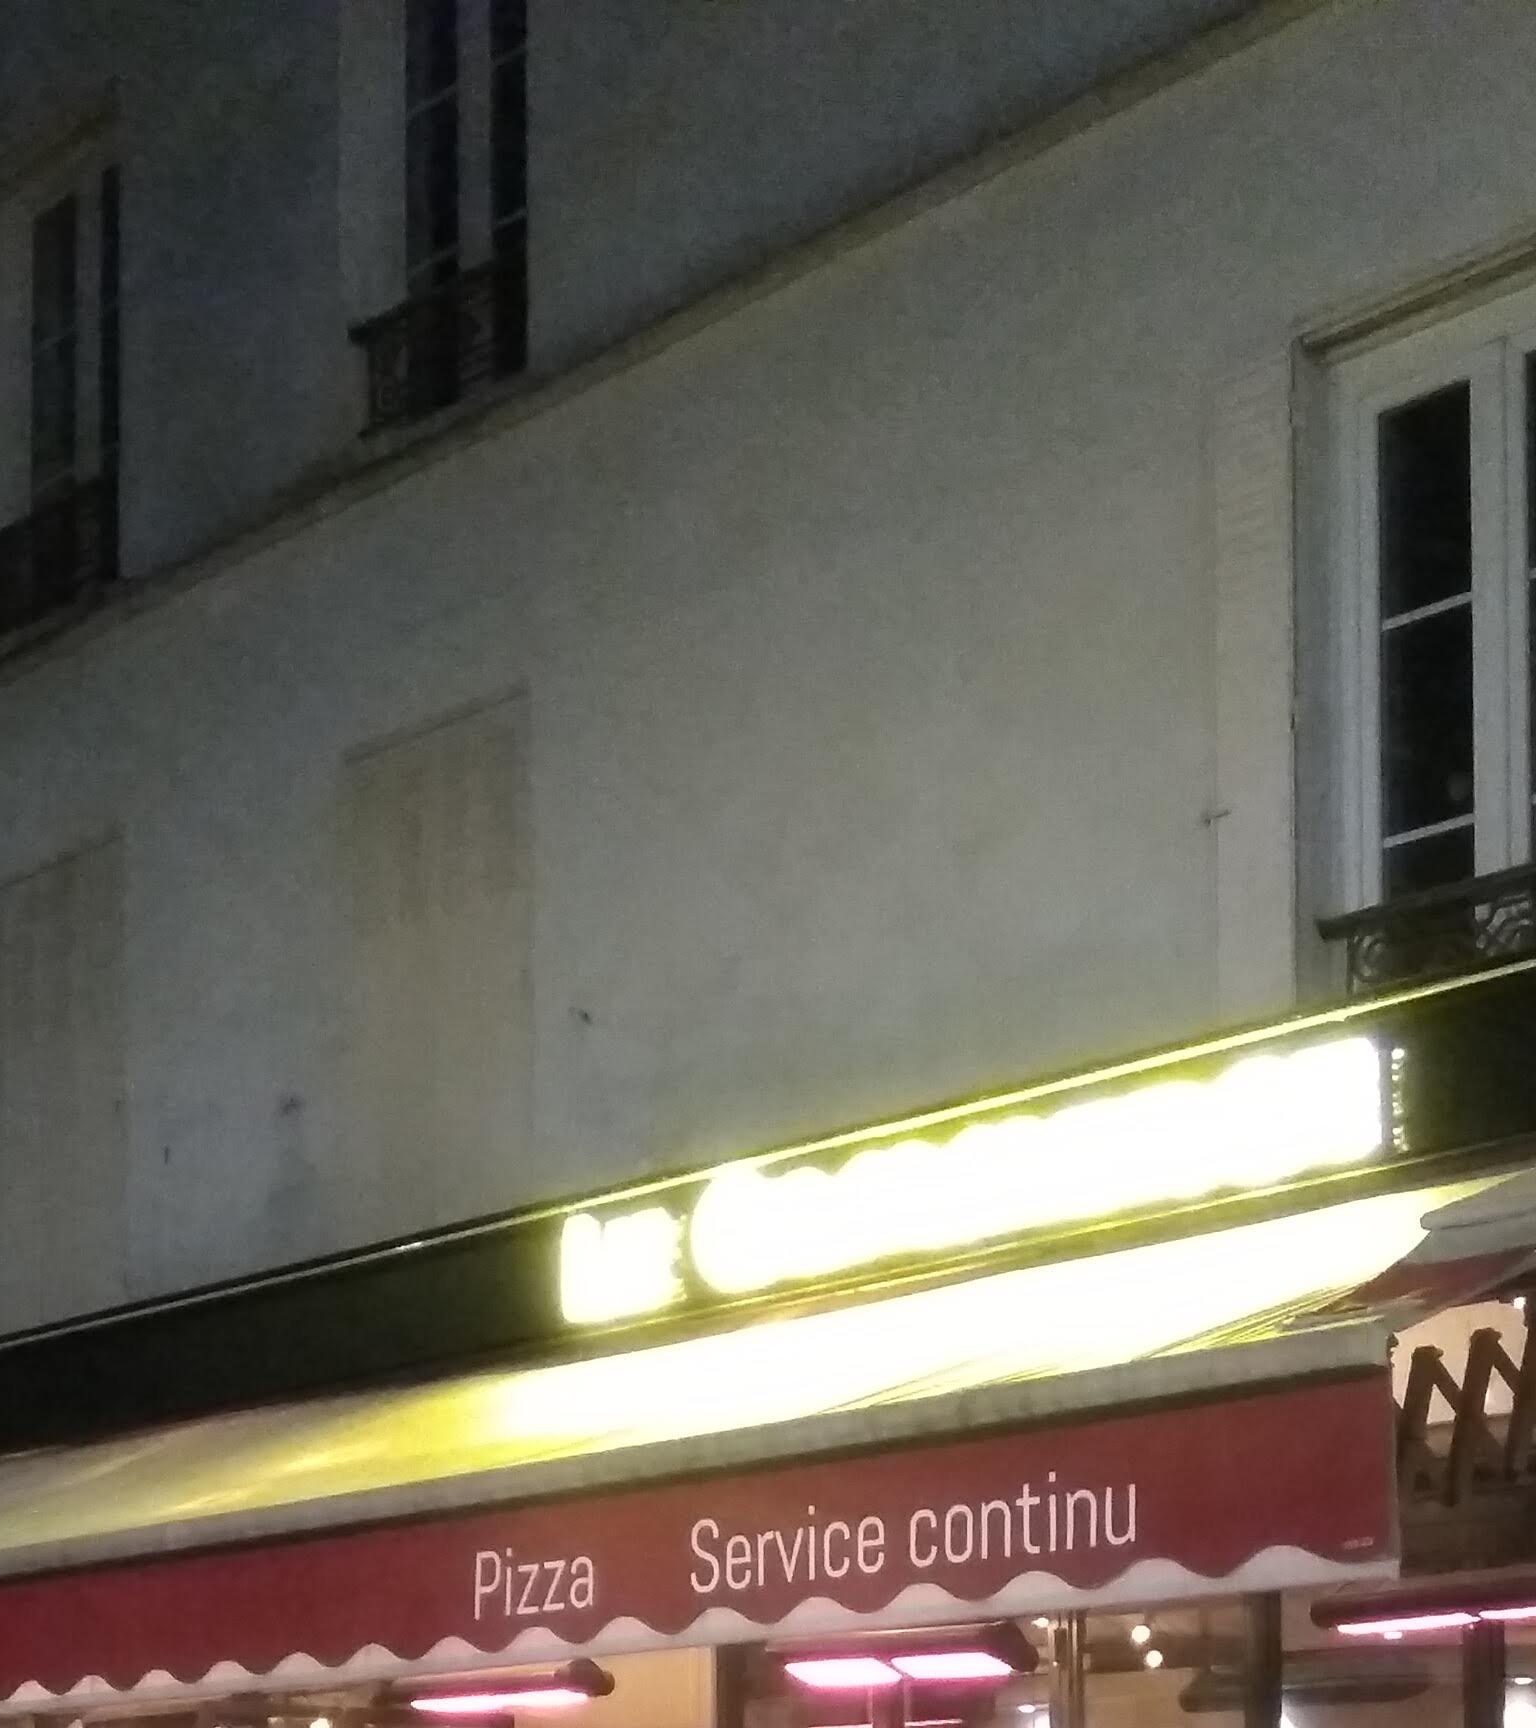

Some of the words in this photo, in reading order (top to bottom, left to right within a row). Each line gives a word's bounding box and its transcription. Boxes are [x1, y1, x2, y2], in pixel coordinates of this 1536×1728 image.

[474, 1546, 594, 1621] Pizza
[690, 1505, 886, 1593] Service
[908, 1471, 1137, 1568] continu
